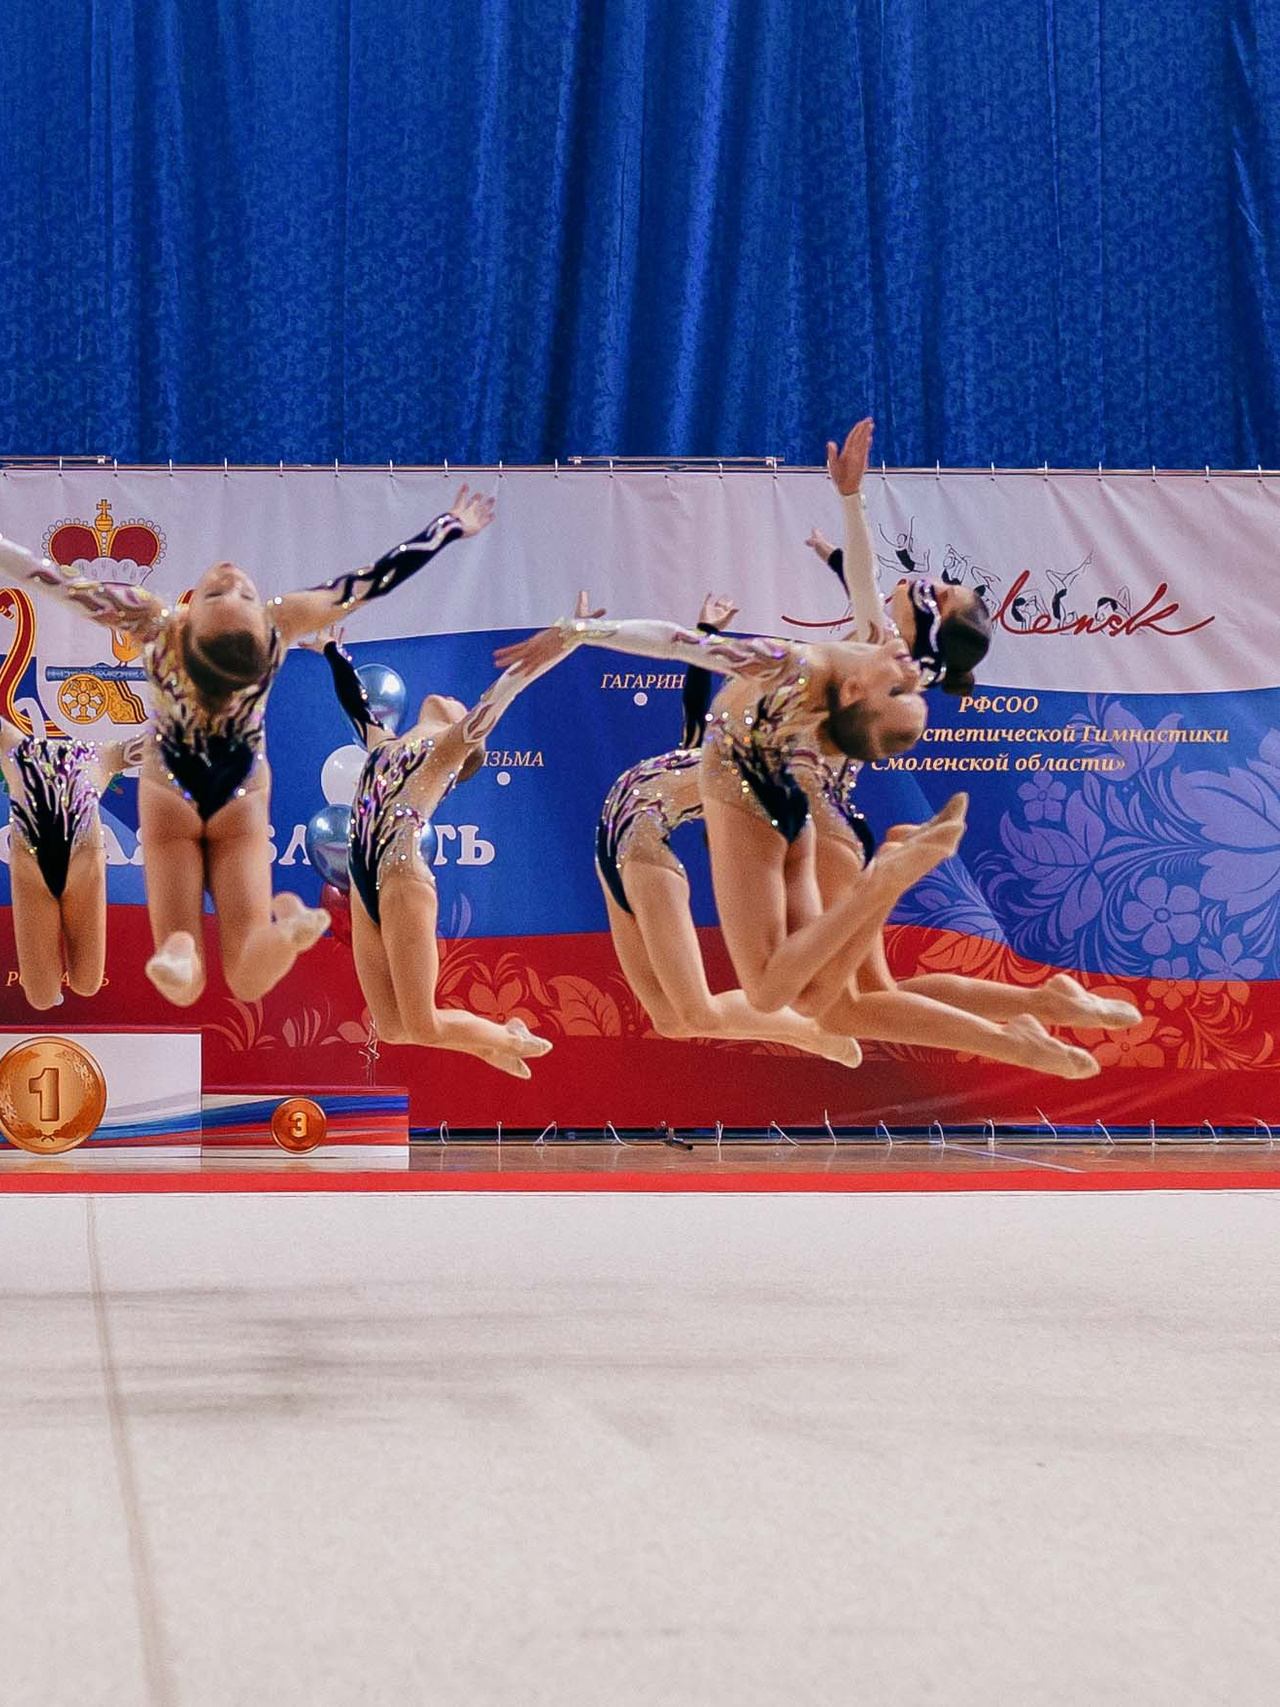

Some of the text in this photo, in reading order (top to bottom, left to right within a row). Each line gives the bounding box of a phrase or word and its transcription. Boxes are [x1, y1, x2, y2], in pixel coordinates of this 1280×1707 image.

[601, 674, 685, 689] ГАГАРИН
[958, 696, 1039, 713] РФСОО
[922, 725, 1230, 743] стетической Гимнастики
[482, 750, 544, 767] ЗЬМА
[1015, 753, 1126, 772] области»
[27, 1066, 60, 1122] 1
[287, 1112, 308, 1138] 3
